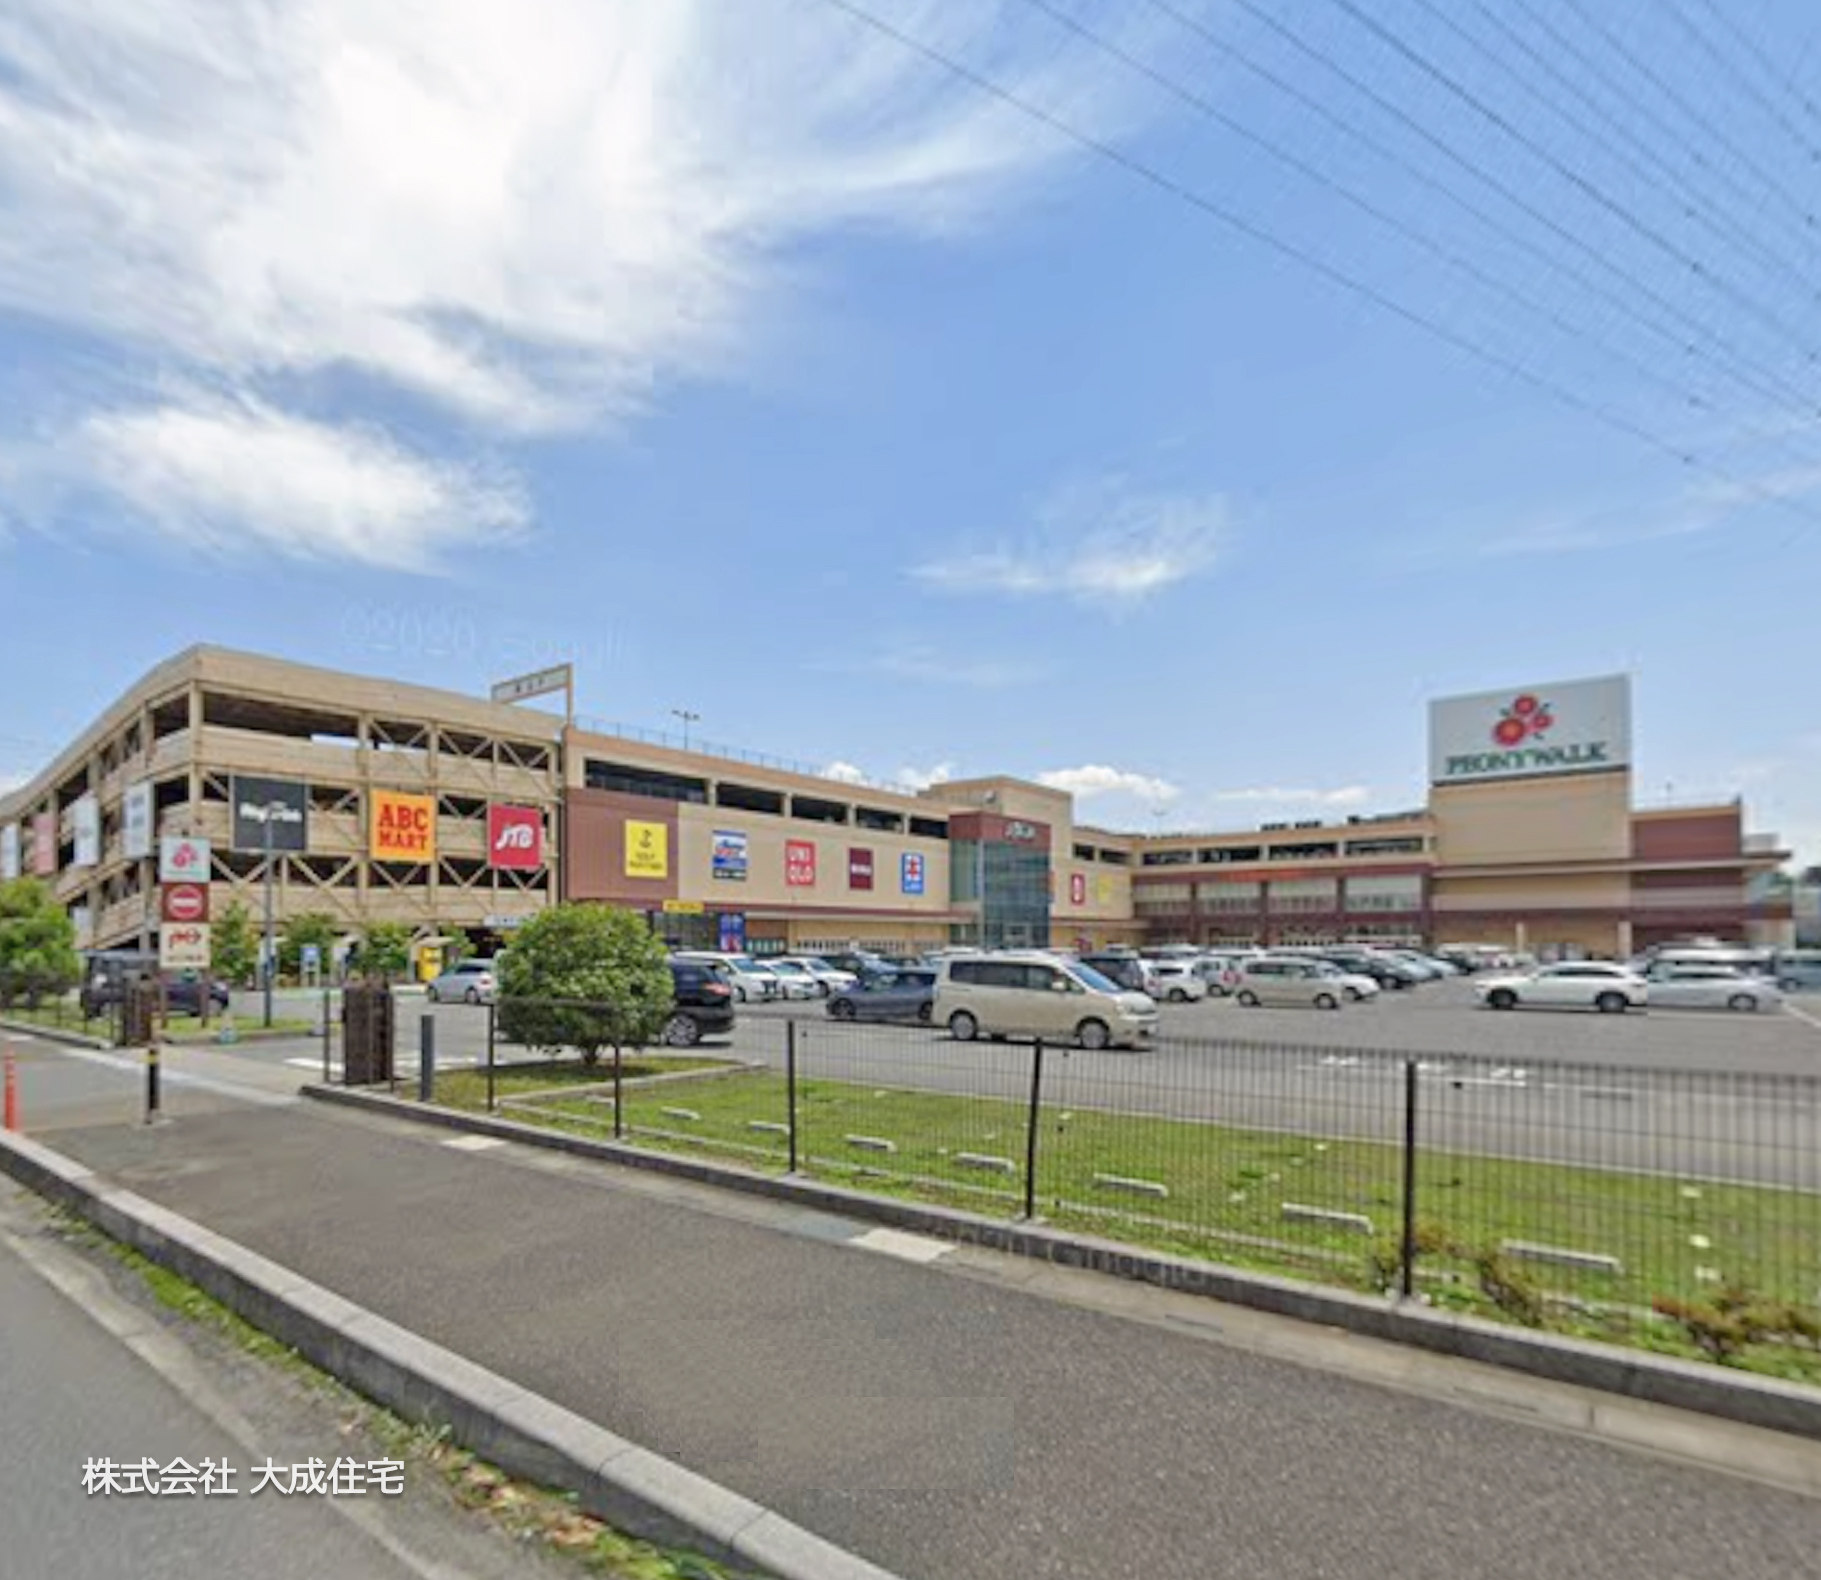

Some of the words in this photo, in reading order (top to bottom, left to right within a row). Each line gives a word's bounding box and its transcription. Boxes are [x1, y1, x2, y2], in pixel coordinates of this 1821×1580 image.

[378, 803, 429, 831] ABC
[378, 830, 428, 850] MART
[494, 823, 534, 850] JTB
